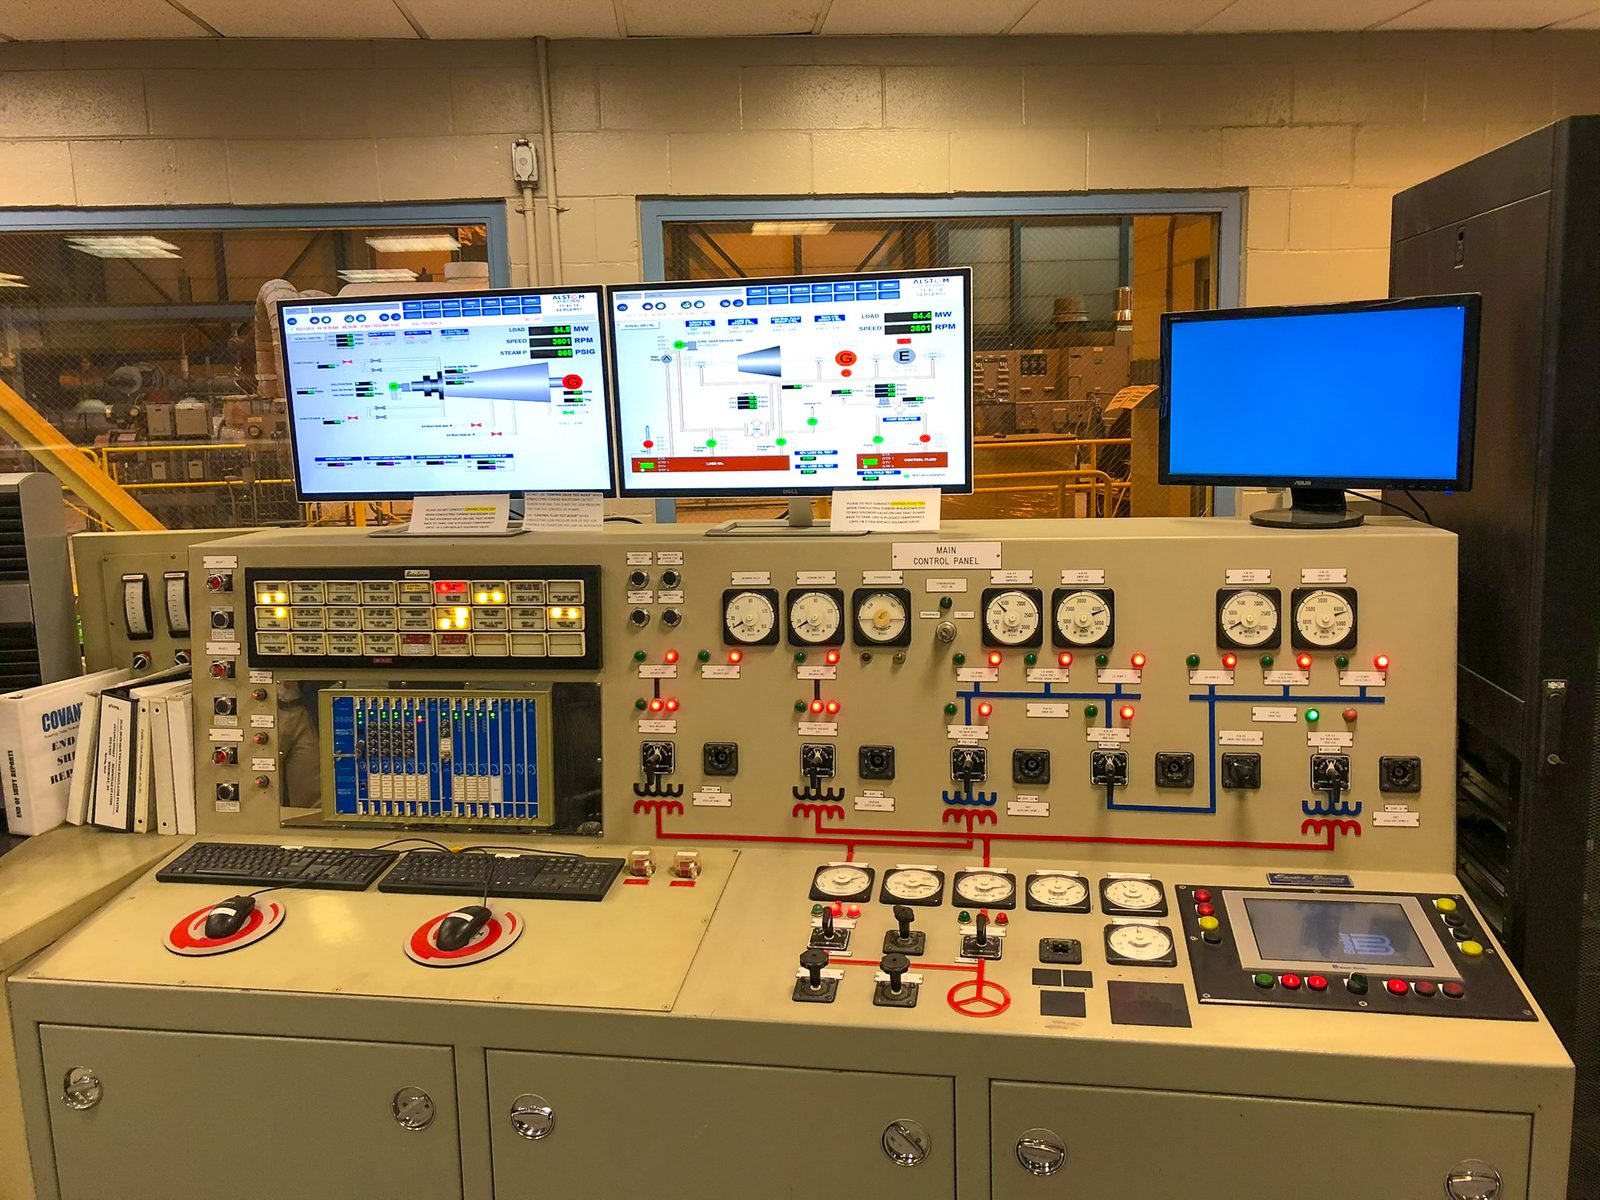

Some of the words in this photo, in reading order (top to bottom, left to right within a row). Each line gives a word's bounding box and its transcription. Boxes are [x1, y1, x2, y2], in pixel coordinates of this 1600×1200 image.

[839, 353, 853, 364] G
[899, 351, 910, 362] E
[566, 377, 579, 387] G
[936, 546, 957, 554] MAIN
[913, 557, 950, 566] CONTROL
[953, 556, 980, 565] PANEL
[42, 701, 83, 733] COVAN
[51, 736, 76, 752] END
[7, 750, 17, 777] REPORTS
[56, 751, 76, 766] SHI
[50, 768, 74, 785] REP
[12, 778, 20, 796] SHIFT
